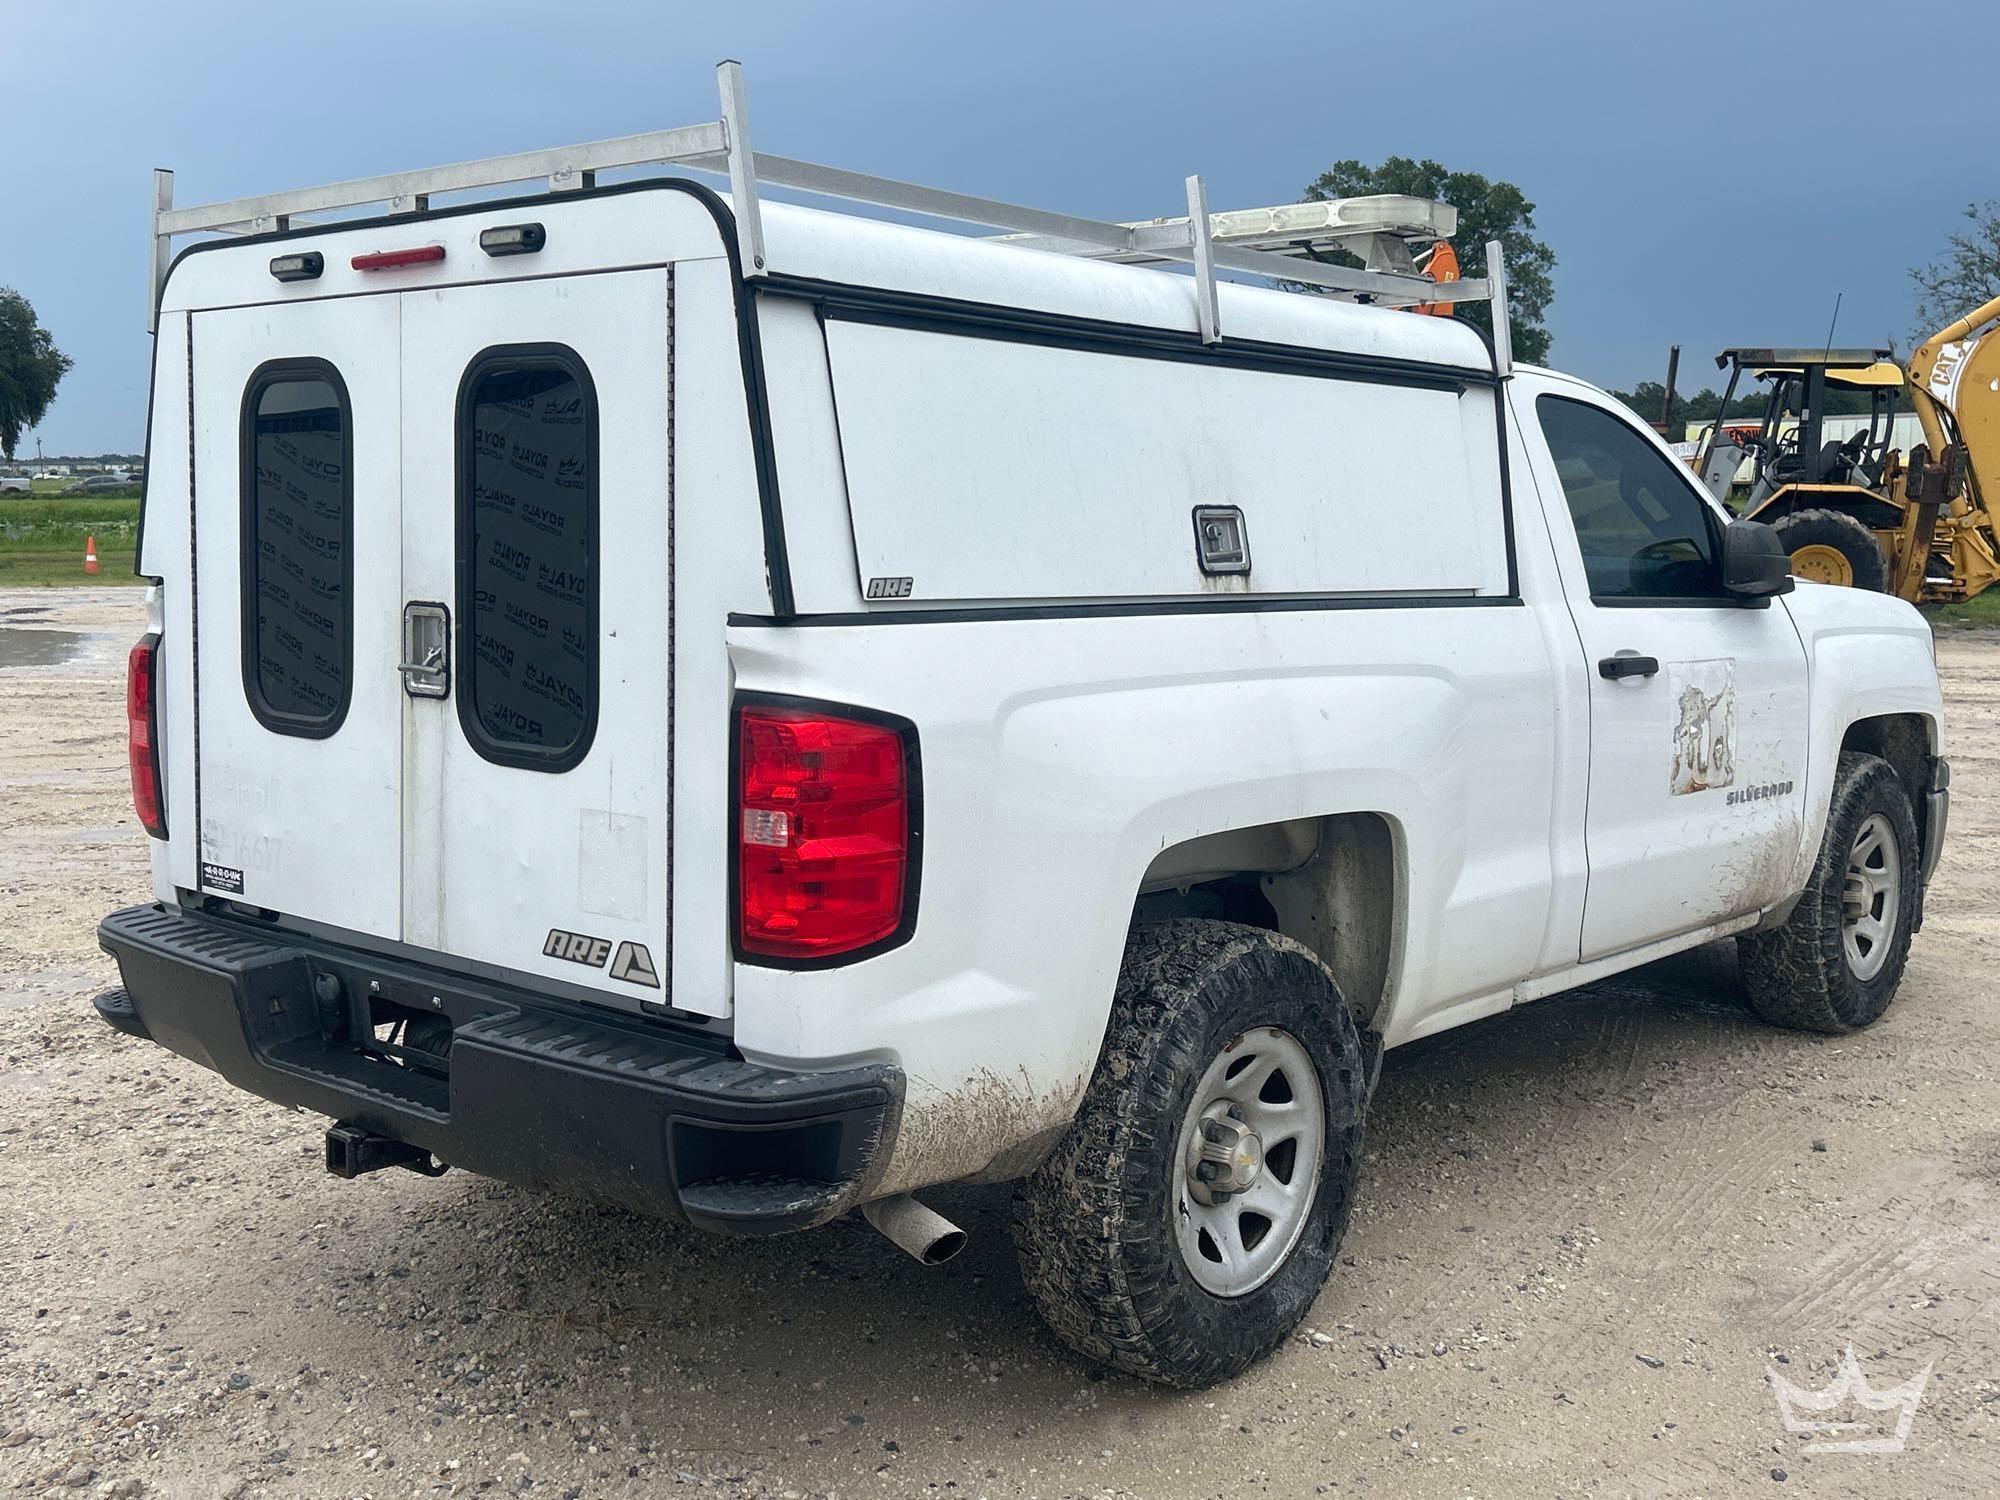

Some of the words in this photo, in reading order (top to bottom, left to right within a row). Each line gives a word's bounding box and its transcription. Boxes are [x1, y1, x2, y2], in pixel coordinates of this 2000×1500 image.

[1931, 353, 1959, 386] CAT
[867, 577, 914, 598] ARE
[1726, 781, 1793, 805] SILVERADO
[543, 929, 612, 968] ARE
